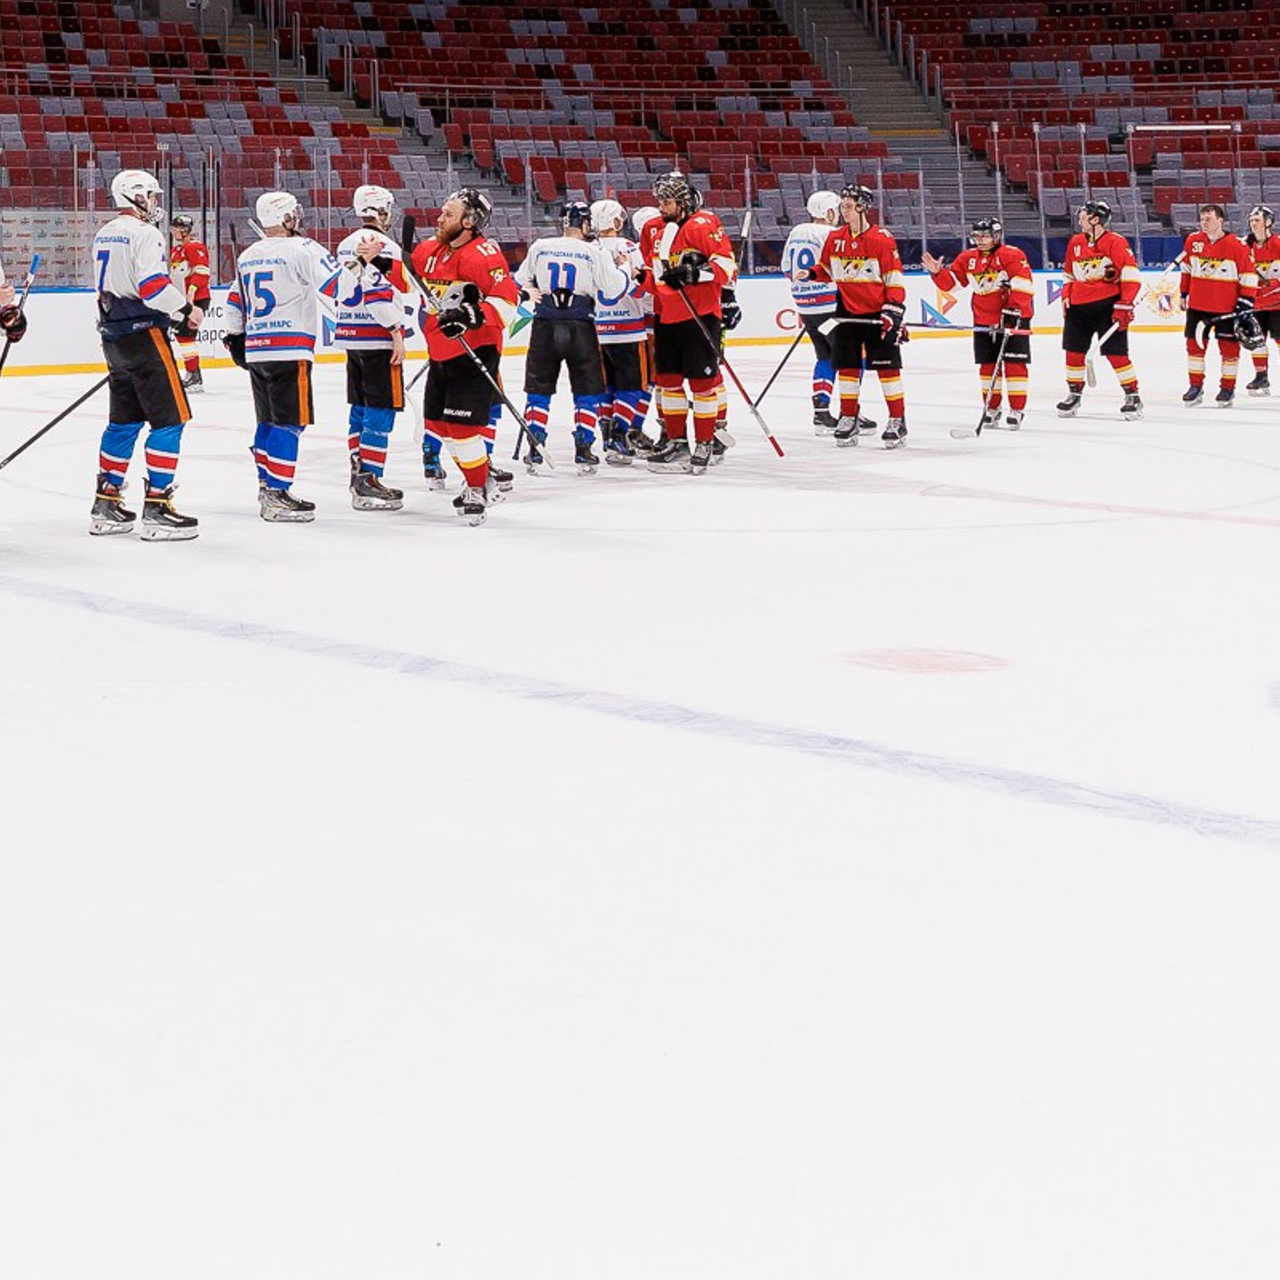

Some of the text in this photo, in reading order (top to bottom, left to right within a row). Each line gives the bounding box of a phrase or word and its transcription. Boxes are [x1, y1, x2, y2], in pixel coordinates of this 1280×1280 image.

[834, 239, 845, 252] 71
[968, 258, 976, 270] 9
[547, 262, 577, 293] 11
[243, 271, 276, 318] 15
[270, 320, 292, 329] МАРС
